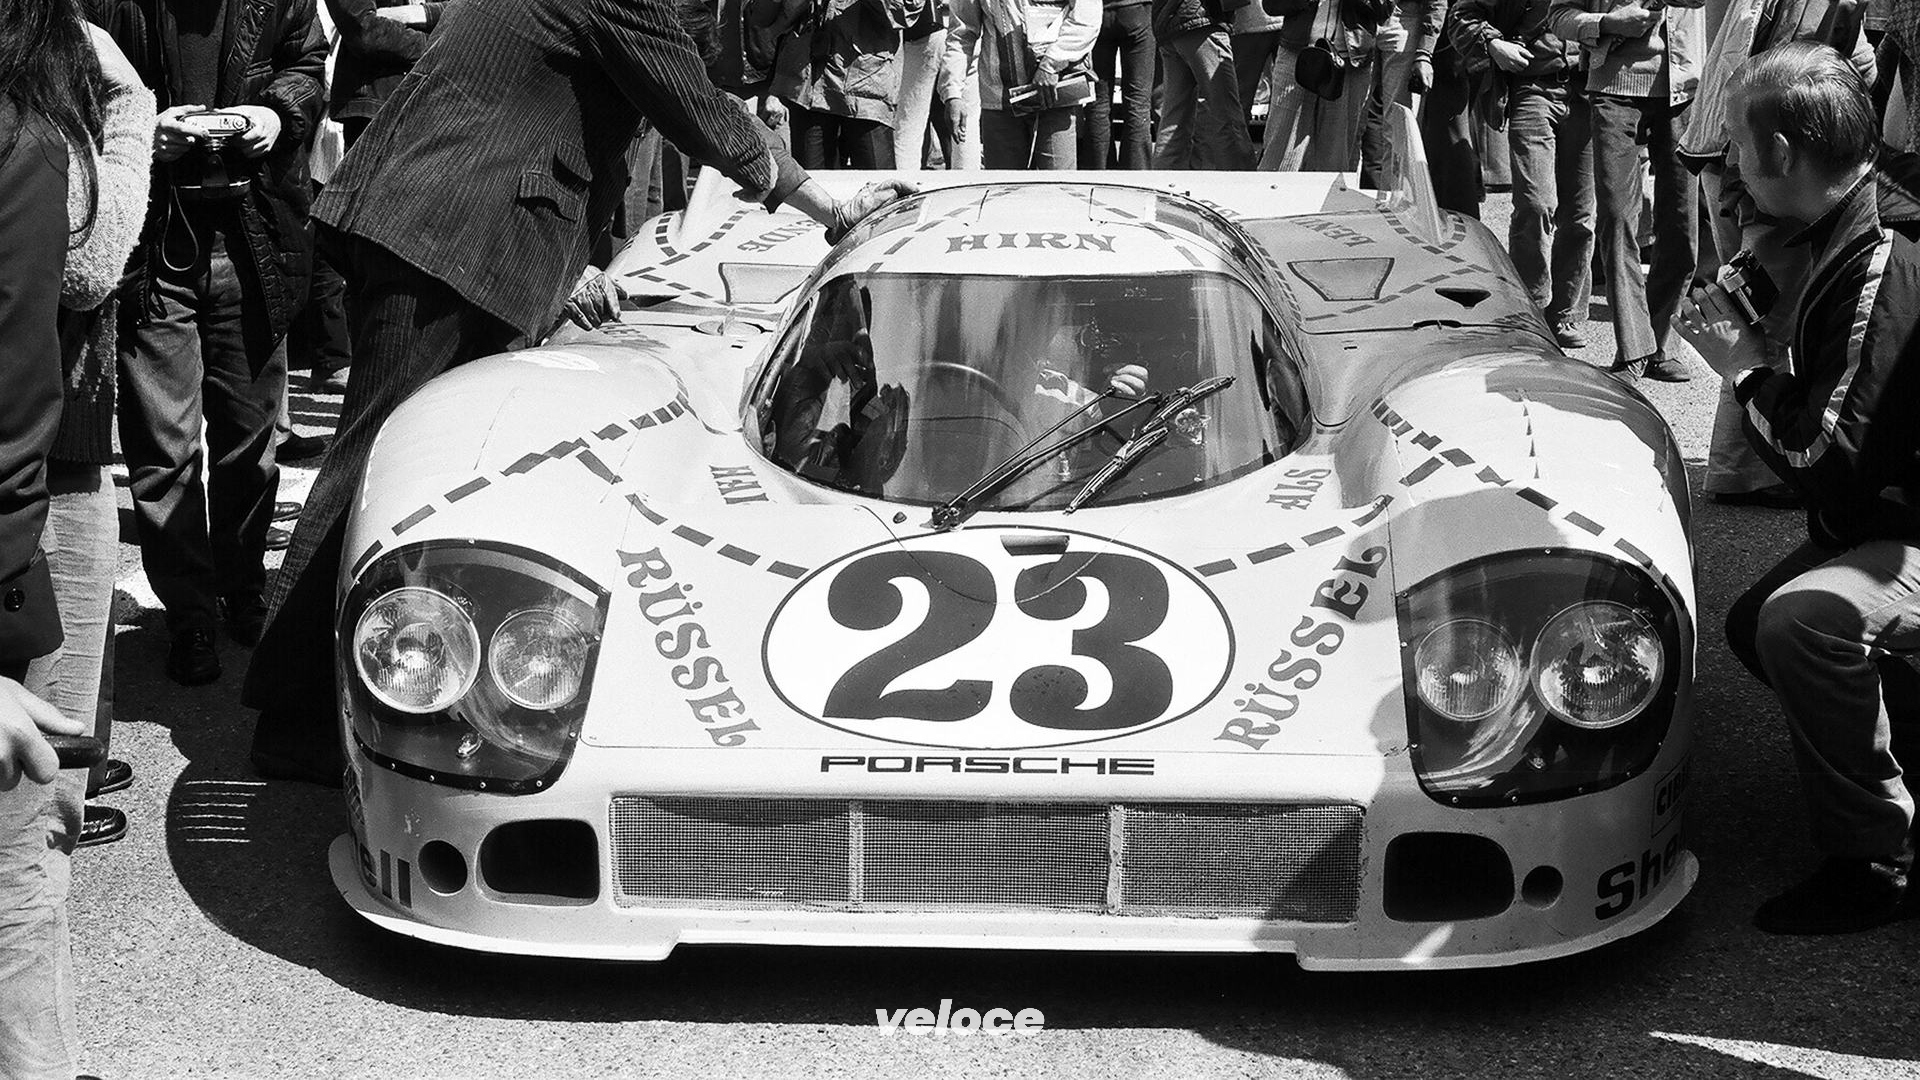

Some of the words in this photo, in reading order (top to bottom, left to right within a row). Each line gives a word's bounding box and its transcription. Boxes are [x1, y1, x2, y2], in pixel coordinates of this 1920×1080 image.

[945, 232, 1116, 253] HIRN
[616, 547, 761, 747] RÜSSEL
[822, 550, 1173, 730] 23
[1213, 546, 1387, 750] RÜSSEL
[820, 756, 1155, 775] PORSCHE
[1595, 832, 1681, 920] She
